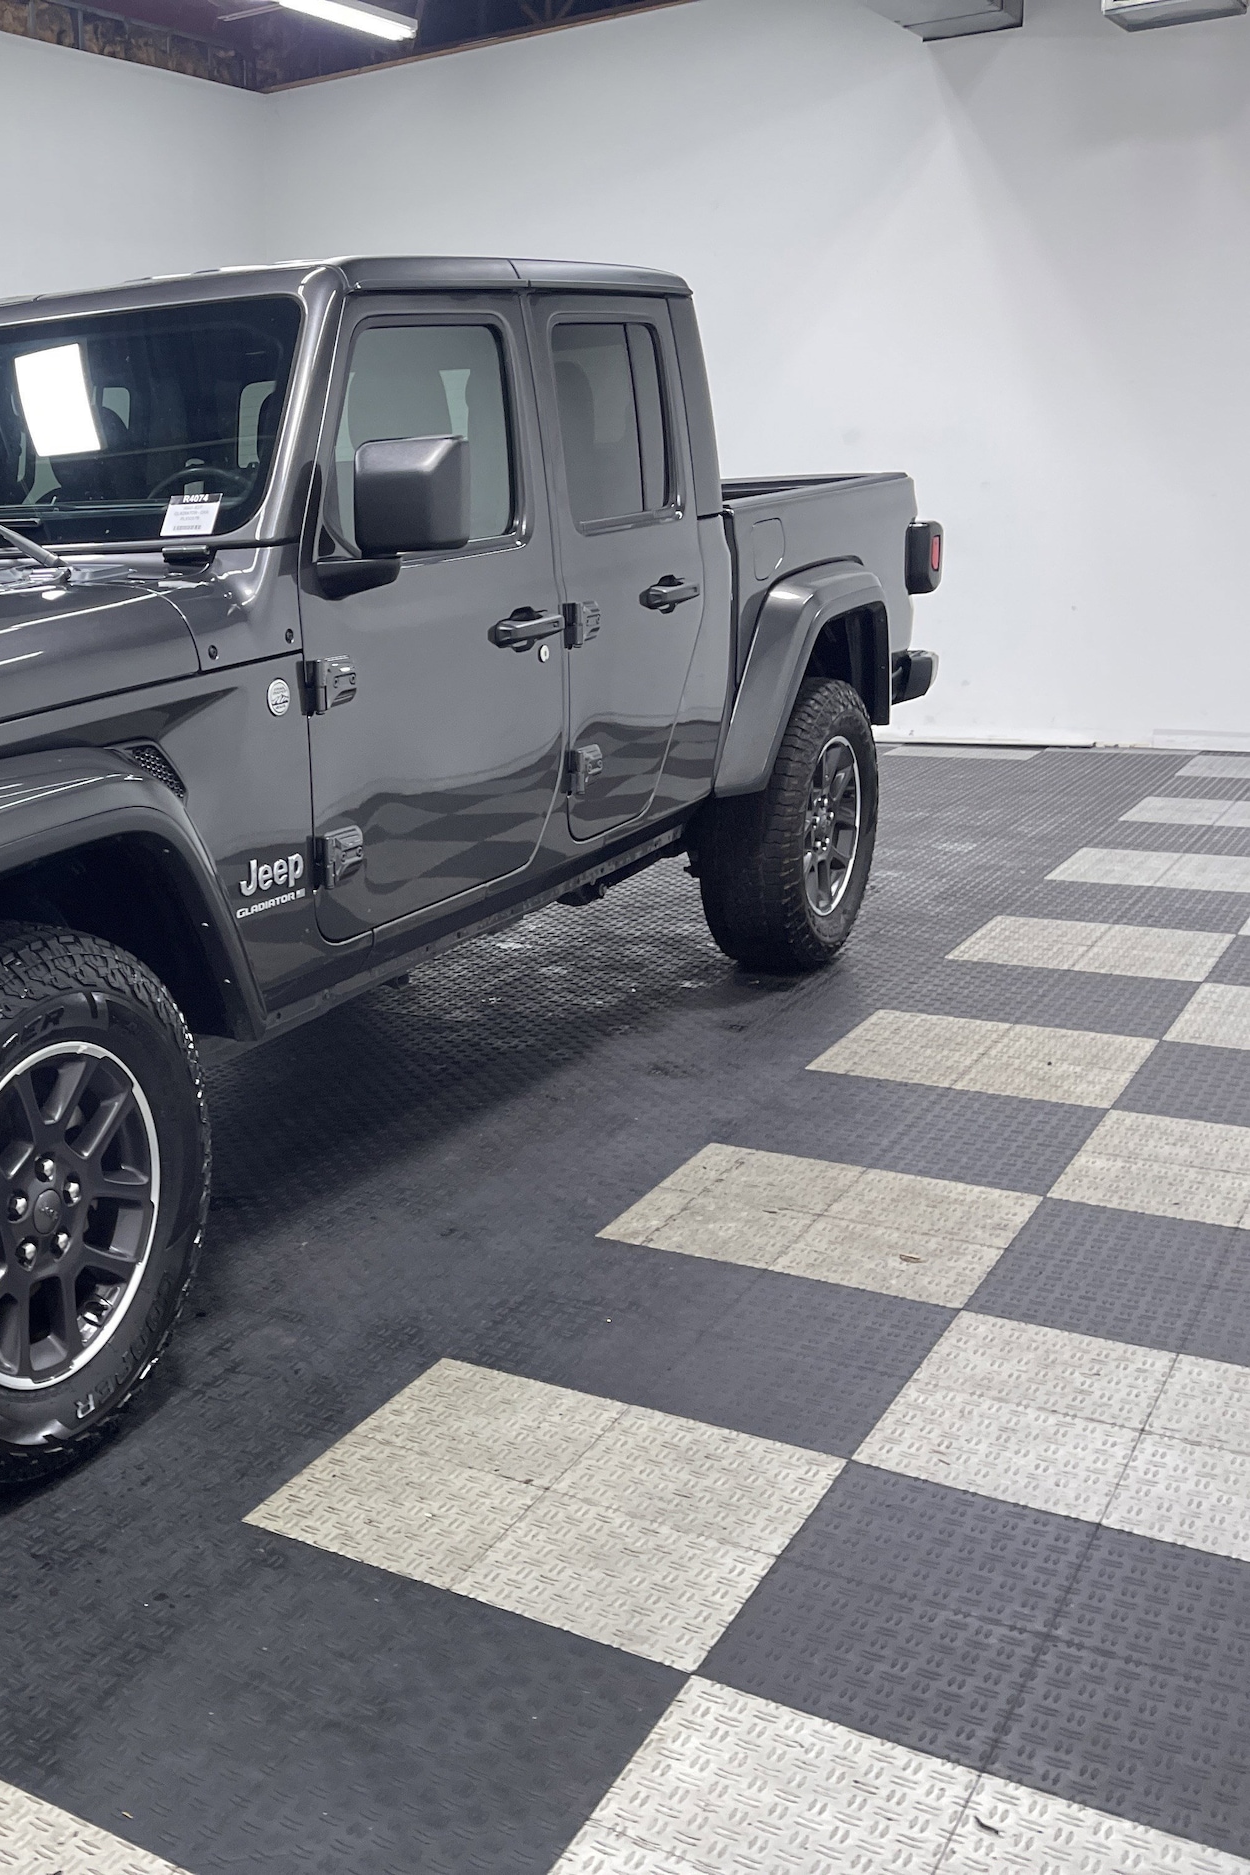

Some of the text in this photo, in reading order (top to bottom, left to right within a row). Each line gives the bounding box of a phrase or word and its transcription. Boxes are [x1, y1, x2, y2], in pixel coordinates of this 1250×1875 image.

[183, 494, 209, 502] R4074
[239, 853, 304, 896] Jeep
[236, 891, 296, 919] GLADIATOR
